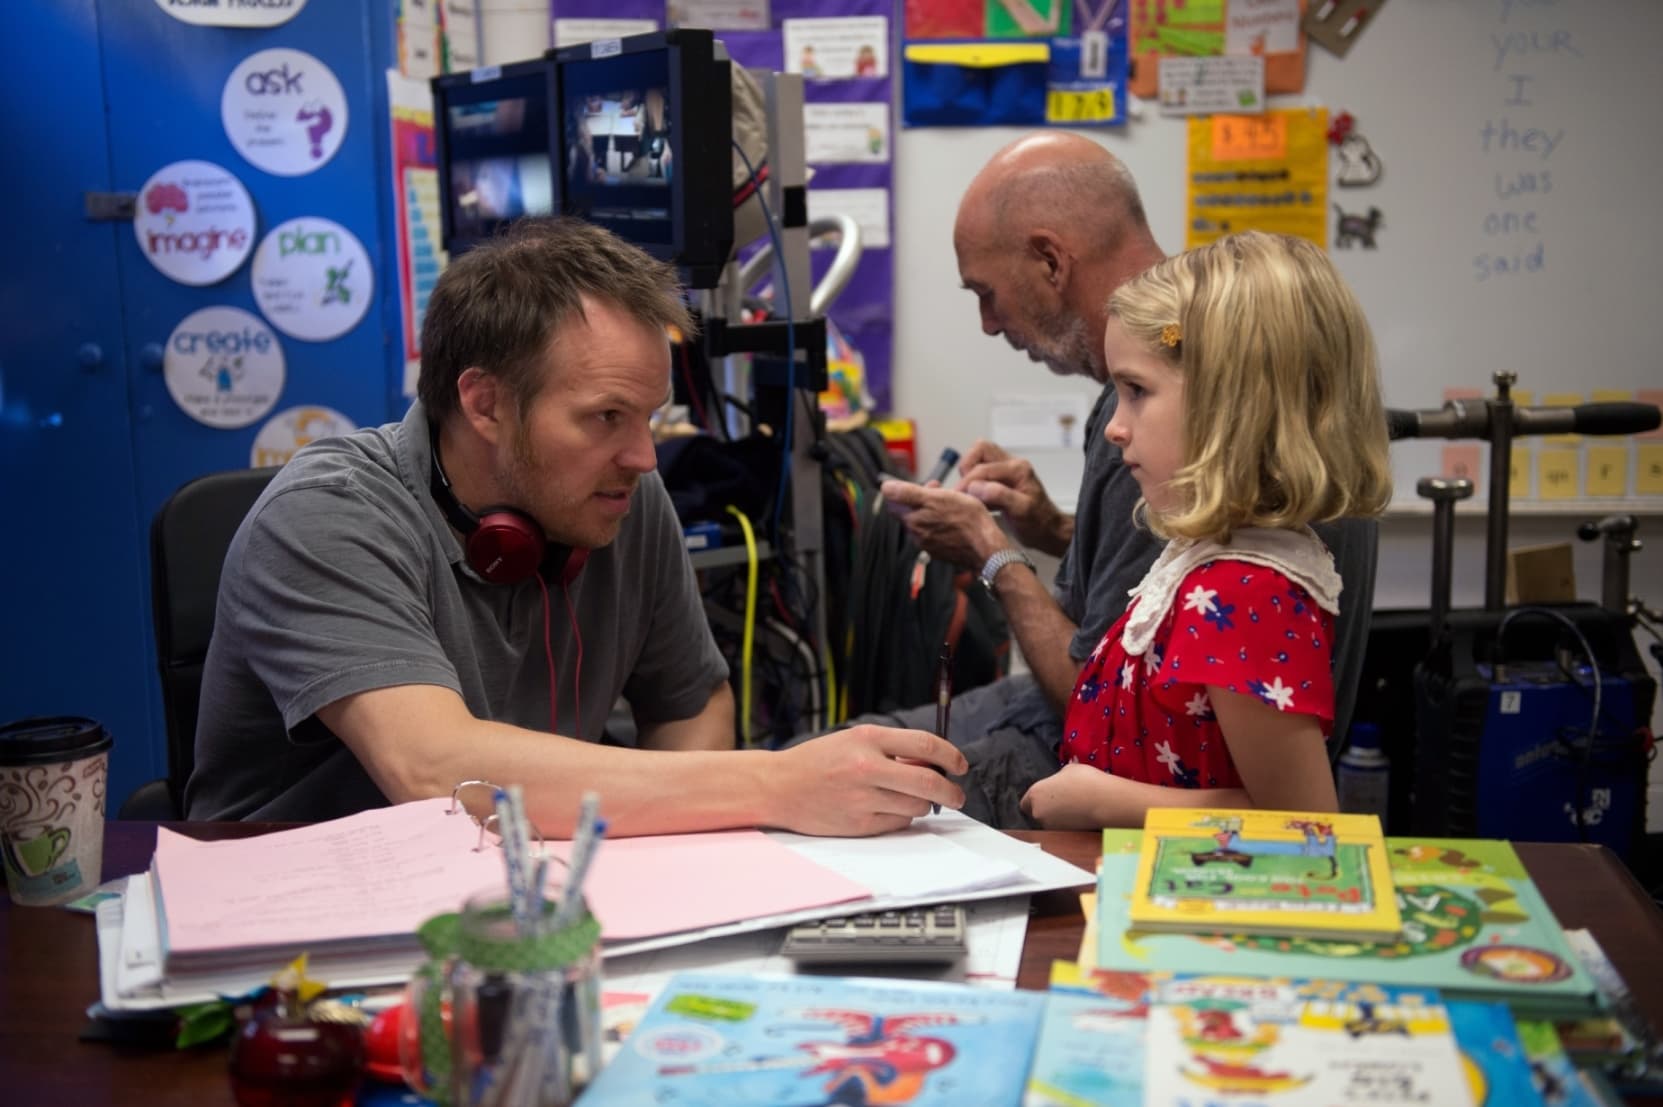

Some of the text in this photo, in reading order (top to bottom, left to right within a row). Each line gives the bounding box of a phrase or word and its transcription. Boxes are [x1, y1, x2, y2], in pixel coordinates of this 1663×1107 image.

[244, 63, 303, 95] ask
[1504, 74, 1534, 107] I
[1480, 118, 1566, 161] they
[1495, 171, 1553, 197] was
[1482, 212, 1540, 236] one
[147, 226, 247, 260] imagine
[277, 224, 341, 258] plan
[1473, 240, 1545, 282] said
[173, 327, 271, 355] create
